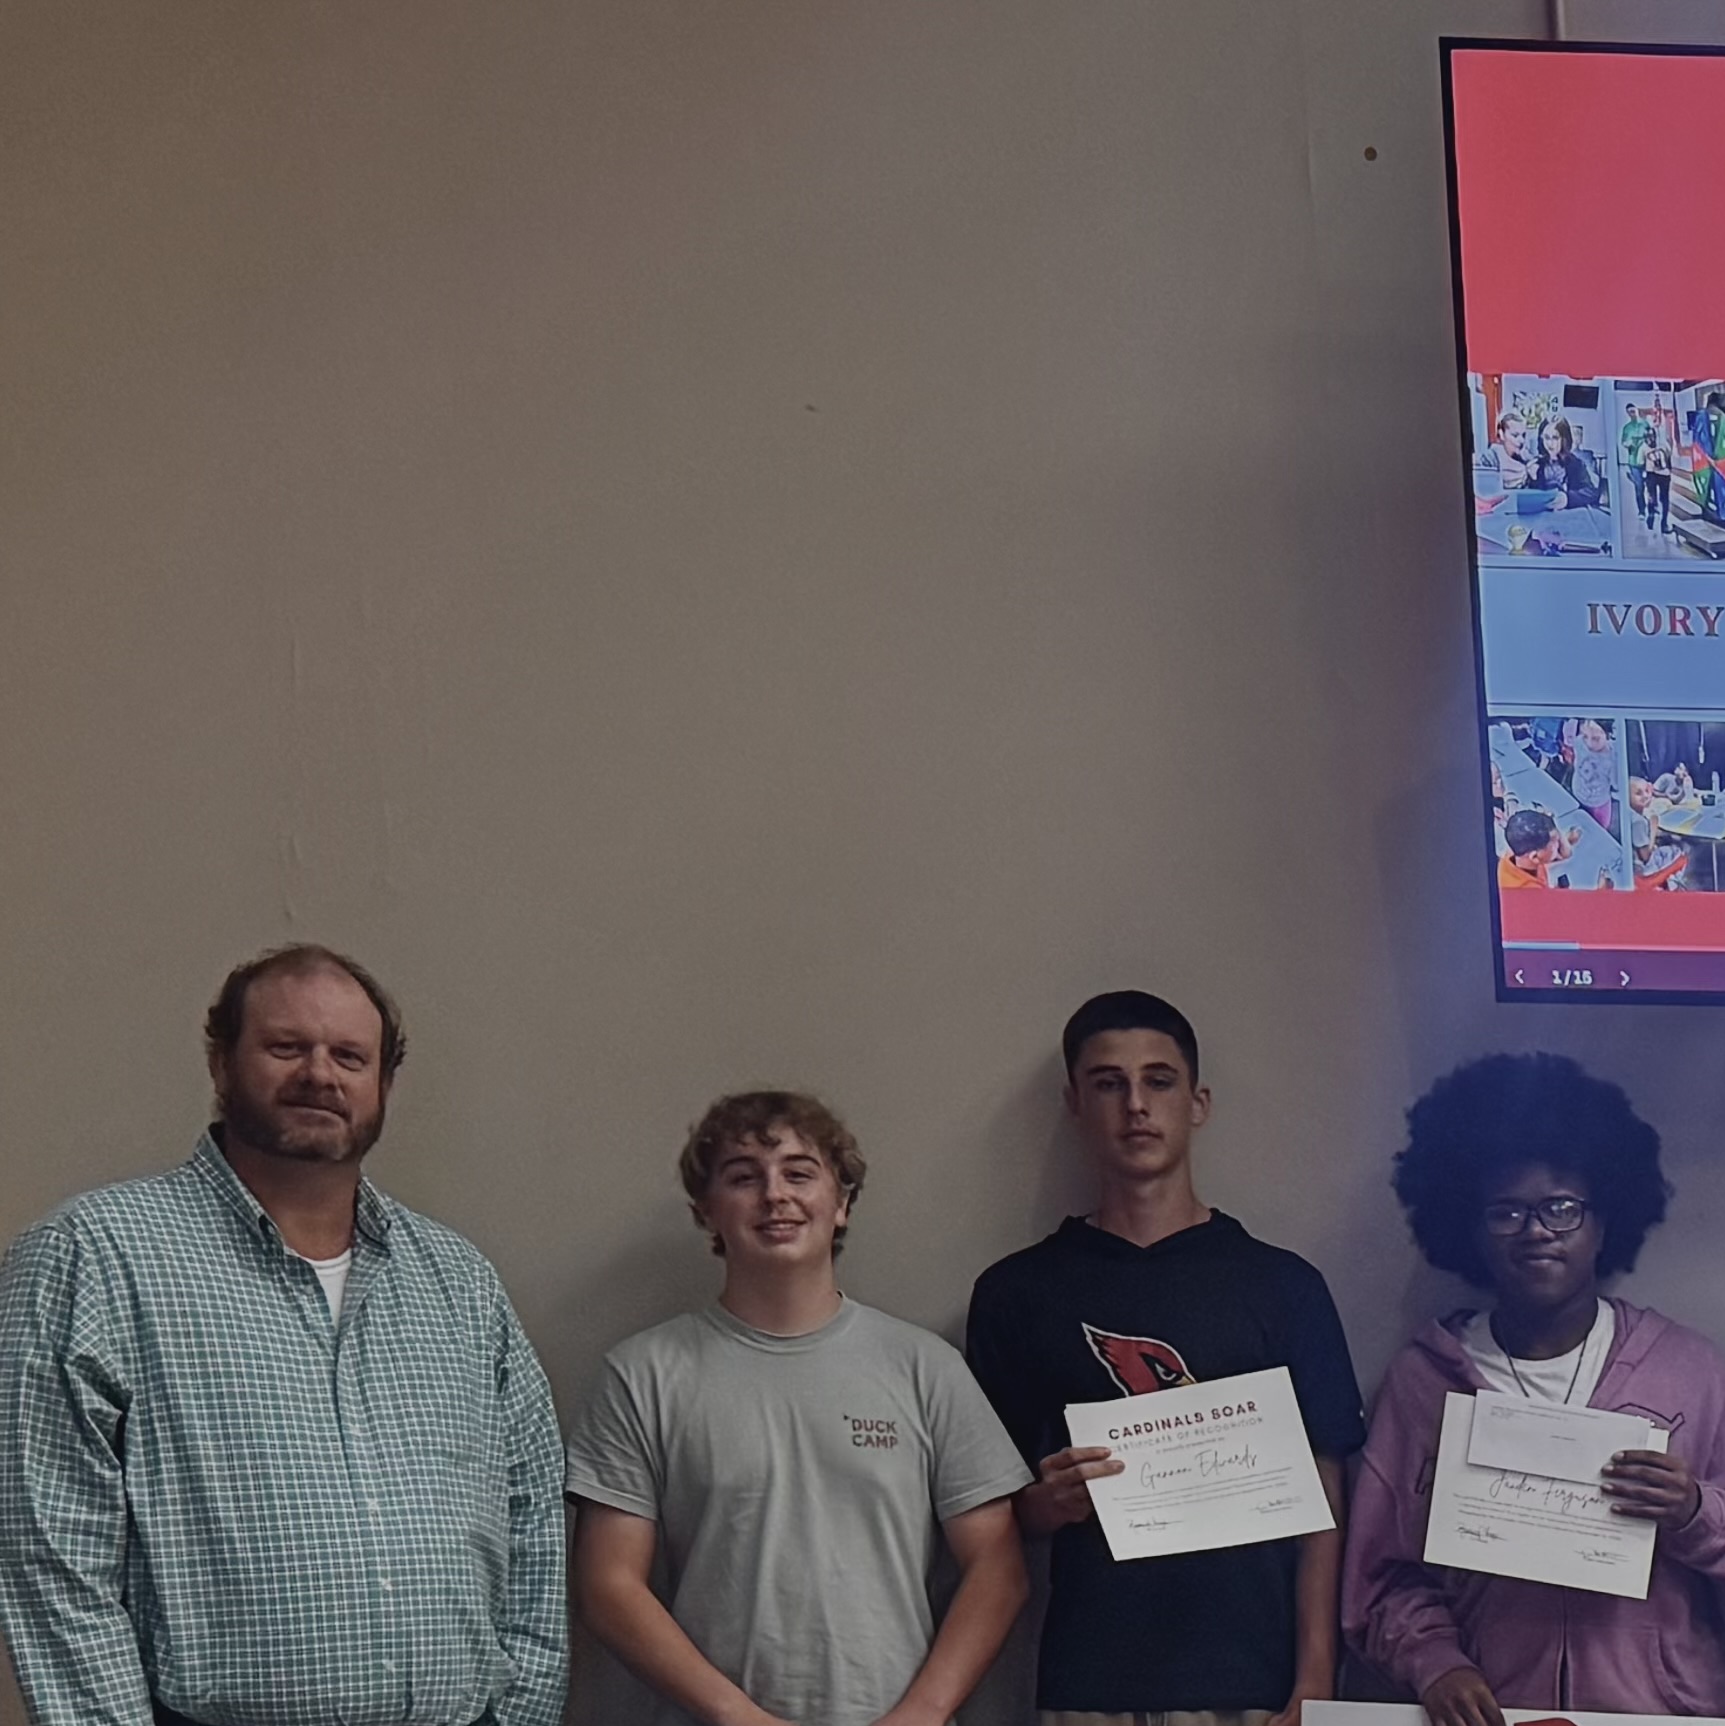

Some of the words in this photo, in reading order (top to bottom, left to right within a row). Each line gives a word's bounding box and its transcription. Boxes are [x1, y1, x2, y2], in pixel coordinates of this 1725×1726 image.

[851, 1417, 898, 1434] DUCK
[1108, 1411, 1205, 1440] CARDINALS
[1211, 1400, 1258, 1420] SOAR
[851, 1433, 899, 1450] CAMP
